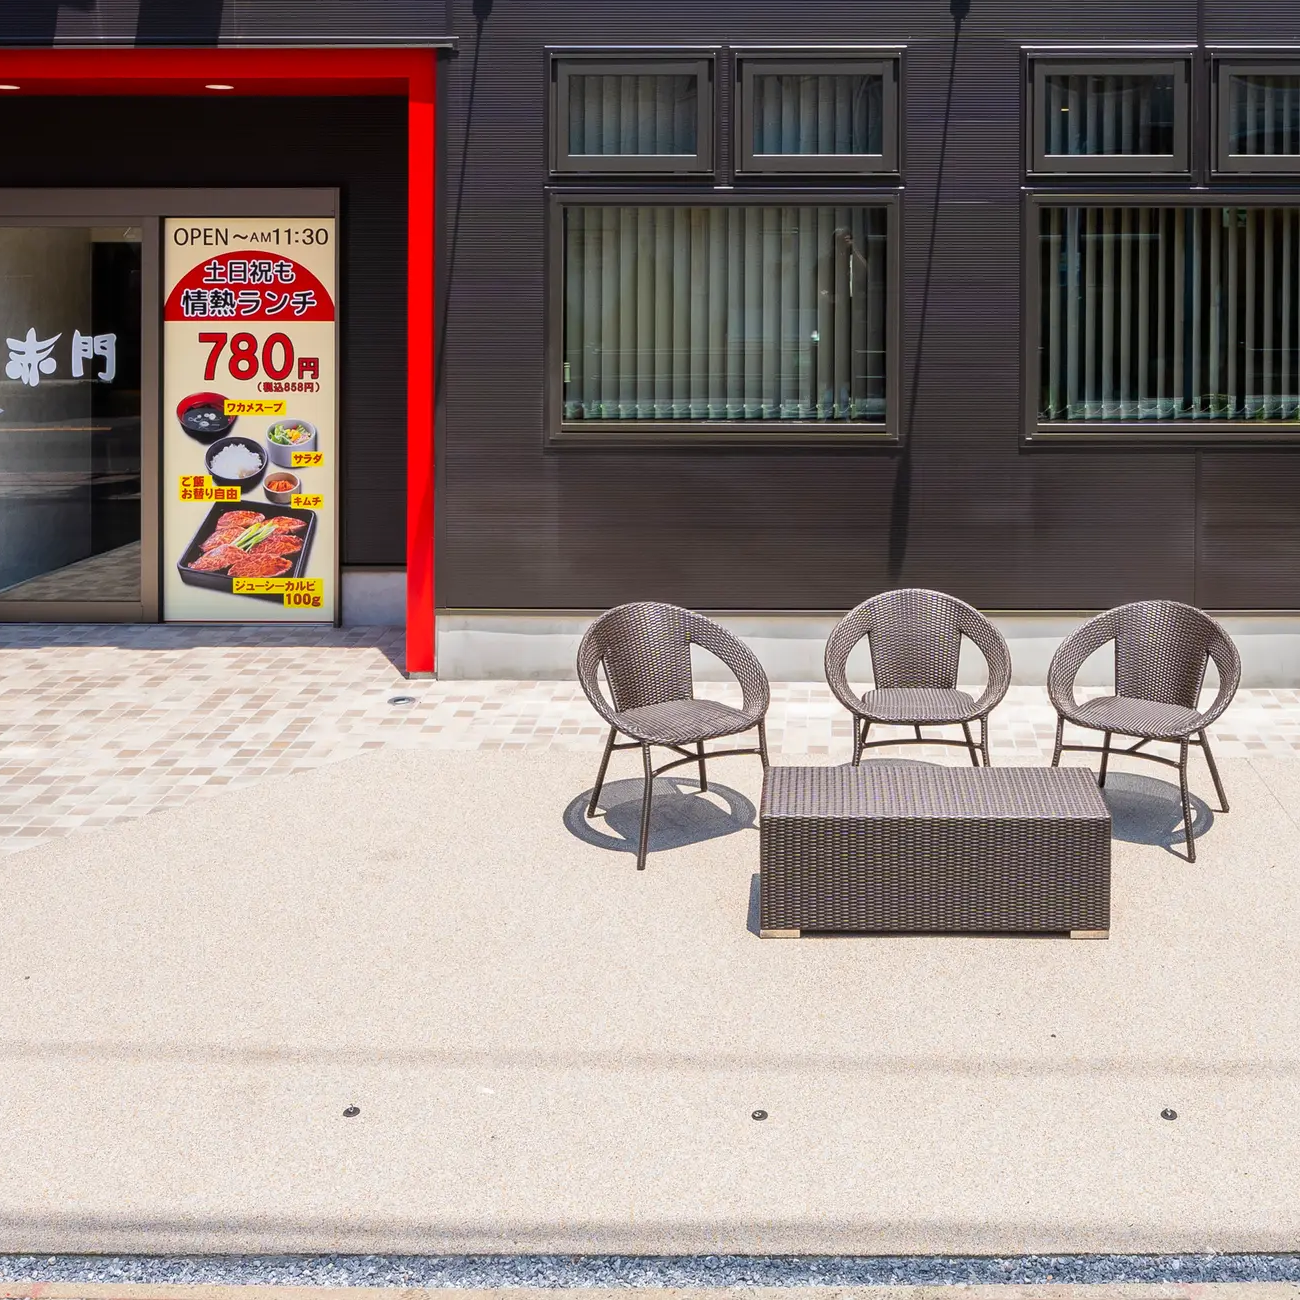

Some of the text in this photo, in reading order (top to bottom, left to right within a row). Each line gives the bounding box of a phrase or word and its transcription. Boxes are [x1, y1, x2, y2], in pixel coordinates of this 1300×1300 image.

[173, 227, 229, 246] OPEN
[202, 259, 296, 285] 土日祝も
[181, 288, 318, 318] 情熱ランチ
[4, 327, 117, 387] 赤門
[198, 332, 320, 381] 780円
[226, 402, 284, 413] ワカメスープ
[293, 453, 323, 465] サラダ
[181, 475, 205, 488] ご飯
[181, 488, 238, 500] お替り自由
[293, 496, 322, 507] キムチ
[235, 580, 317, 592] ジューシーカルビ
[285, 593, 322, 607] 100g
